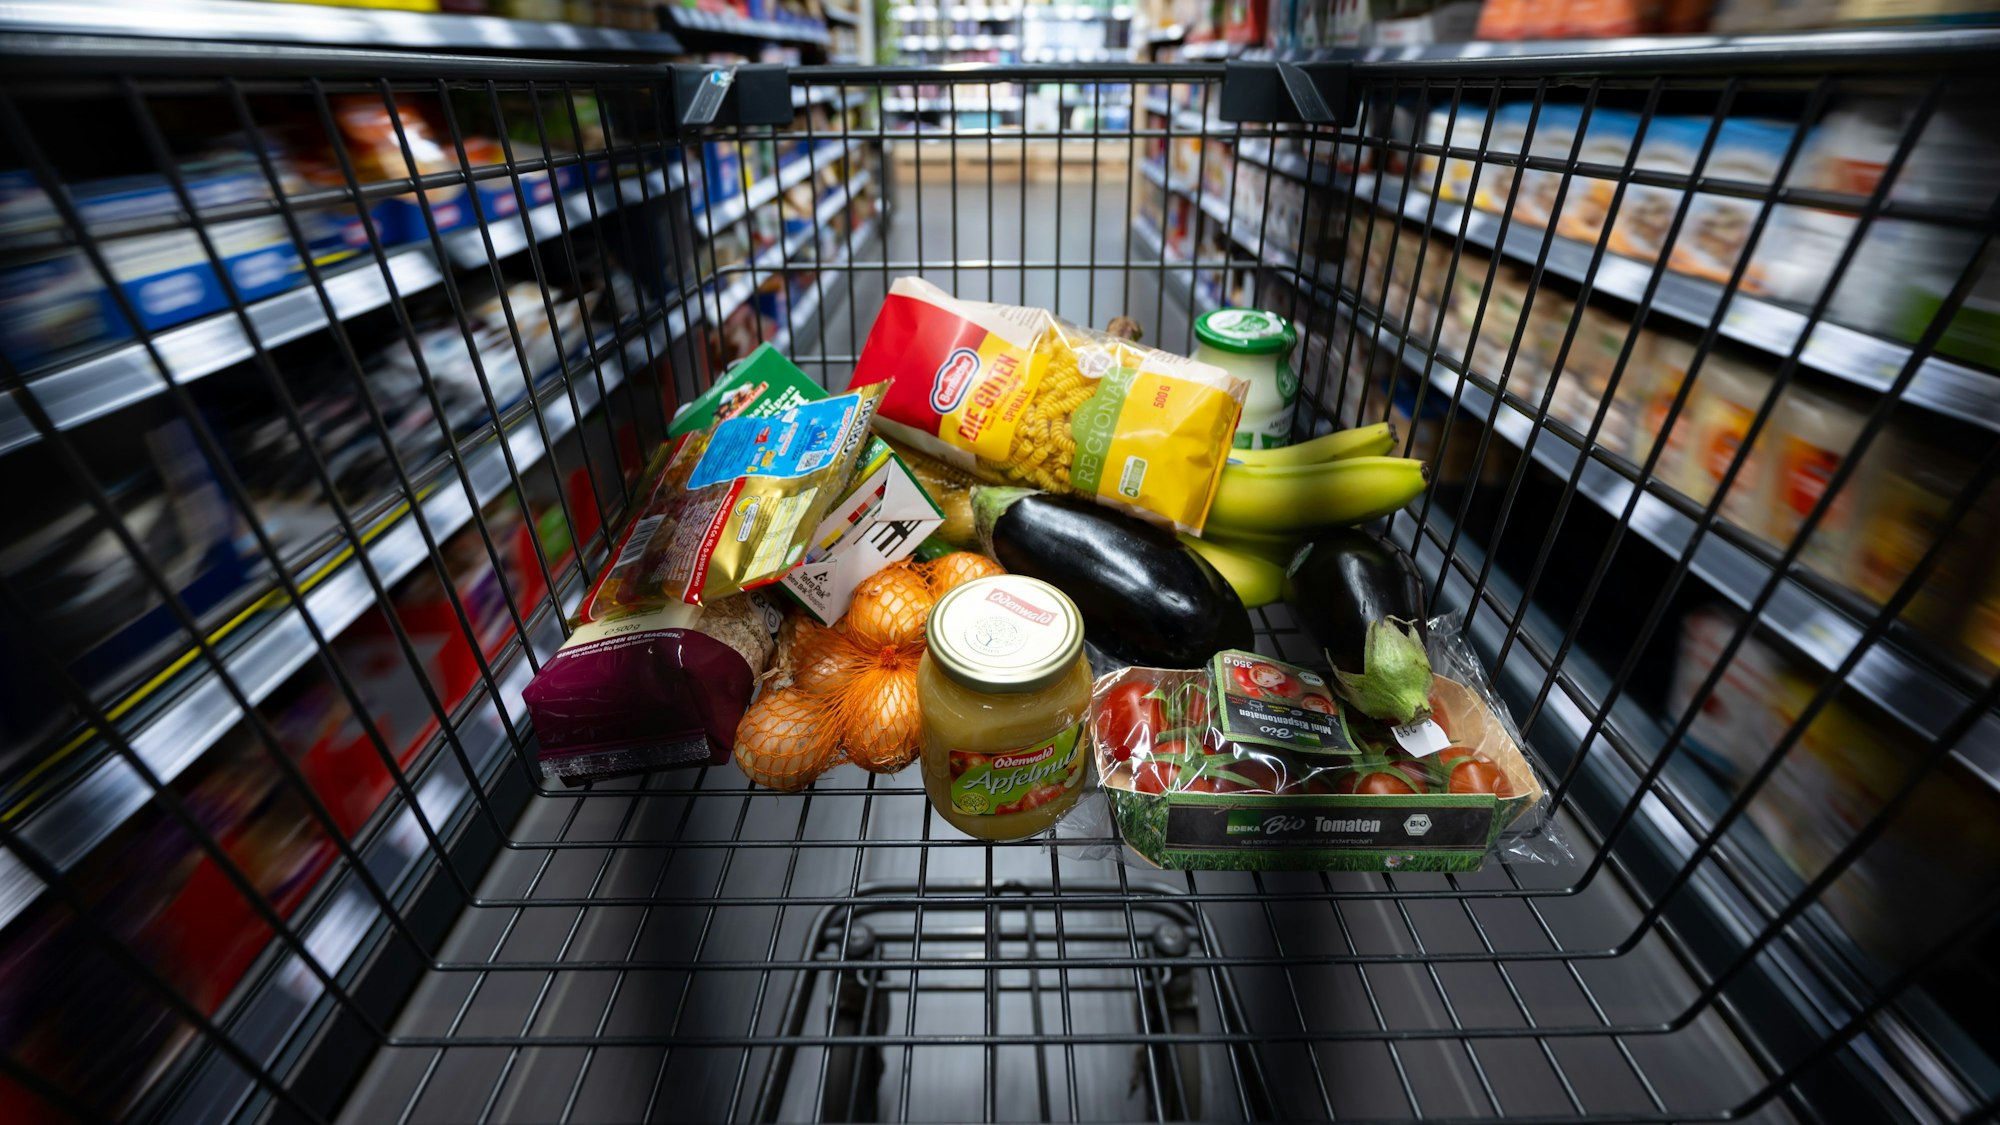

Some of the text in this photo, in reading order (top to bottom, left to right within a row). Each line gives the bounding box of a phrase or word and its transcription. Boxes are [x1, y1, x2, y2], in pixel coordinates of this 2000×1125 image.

[958, 411, 988, 442] DIE
[975, 354, 1019, 410] GUTEN
[1002, 388, 1030, 423] SPIRALE
[1153, 391, 1168, 408] 500
[1077, 369, 1130, 484] REGIONAL
[800, 571, 815, 588] Tetra
[989, 592, 1052, 625] Odenwald
[557, 643, 601, 659] GEMEINSAM
[600, 637, 626, 646] BODEN
[644, 631, 681, 639] MACHEN.
[1233, 659, 1253, 669] 350
[1239, 708, 1308, 732] Rispentomaten
[1311, 723, 1332, 735] Mini
[1259, 725, 1293, 740] Bio
[994, 747, 1053, 768] Odenwald
[1227, 815, 1381, 836] EDEKA Bio Tomaten
